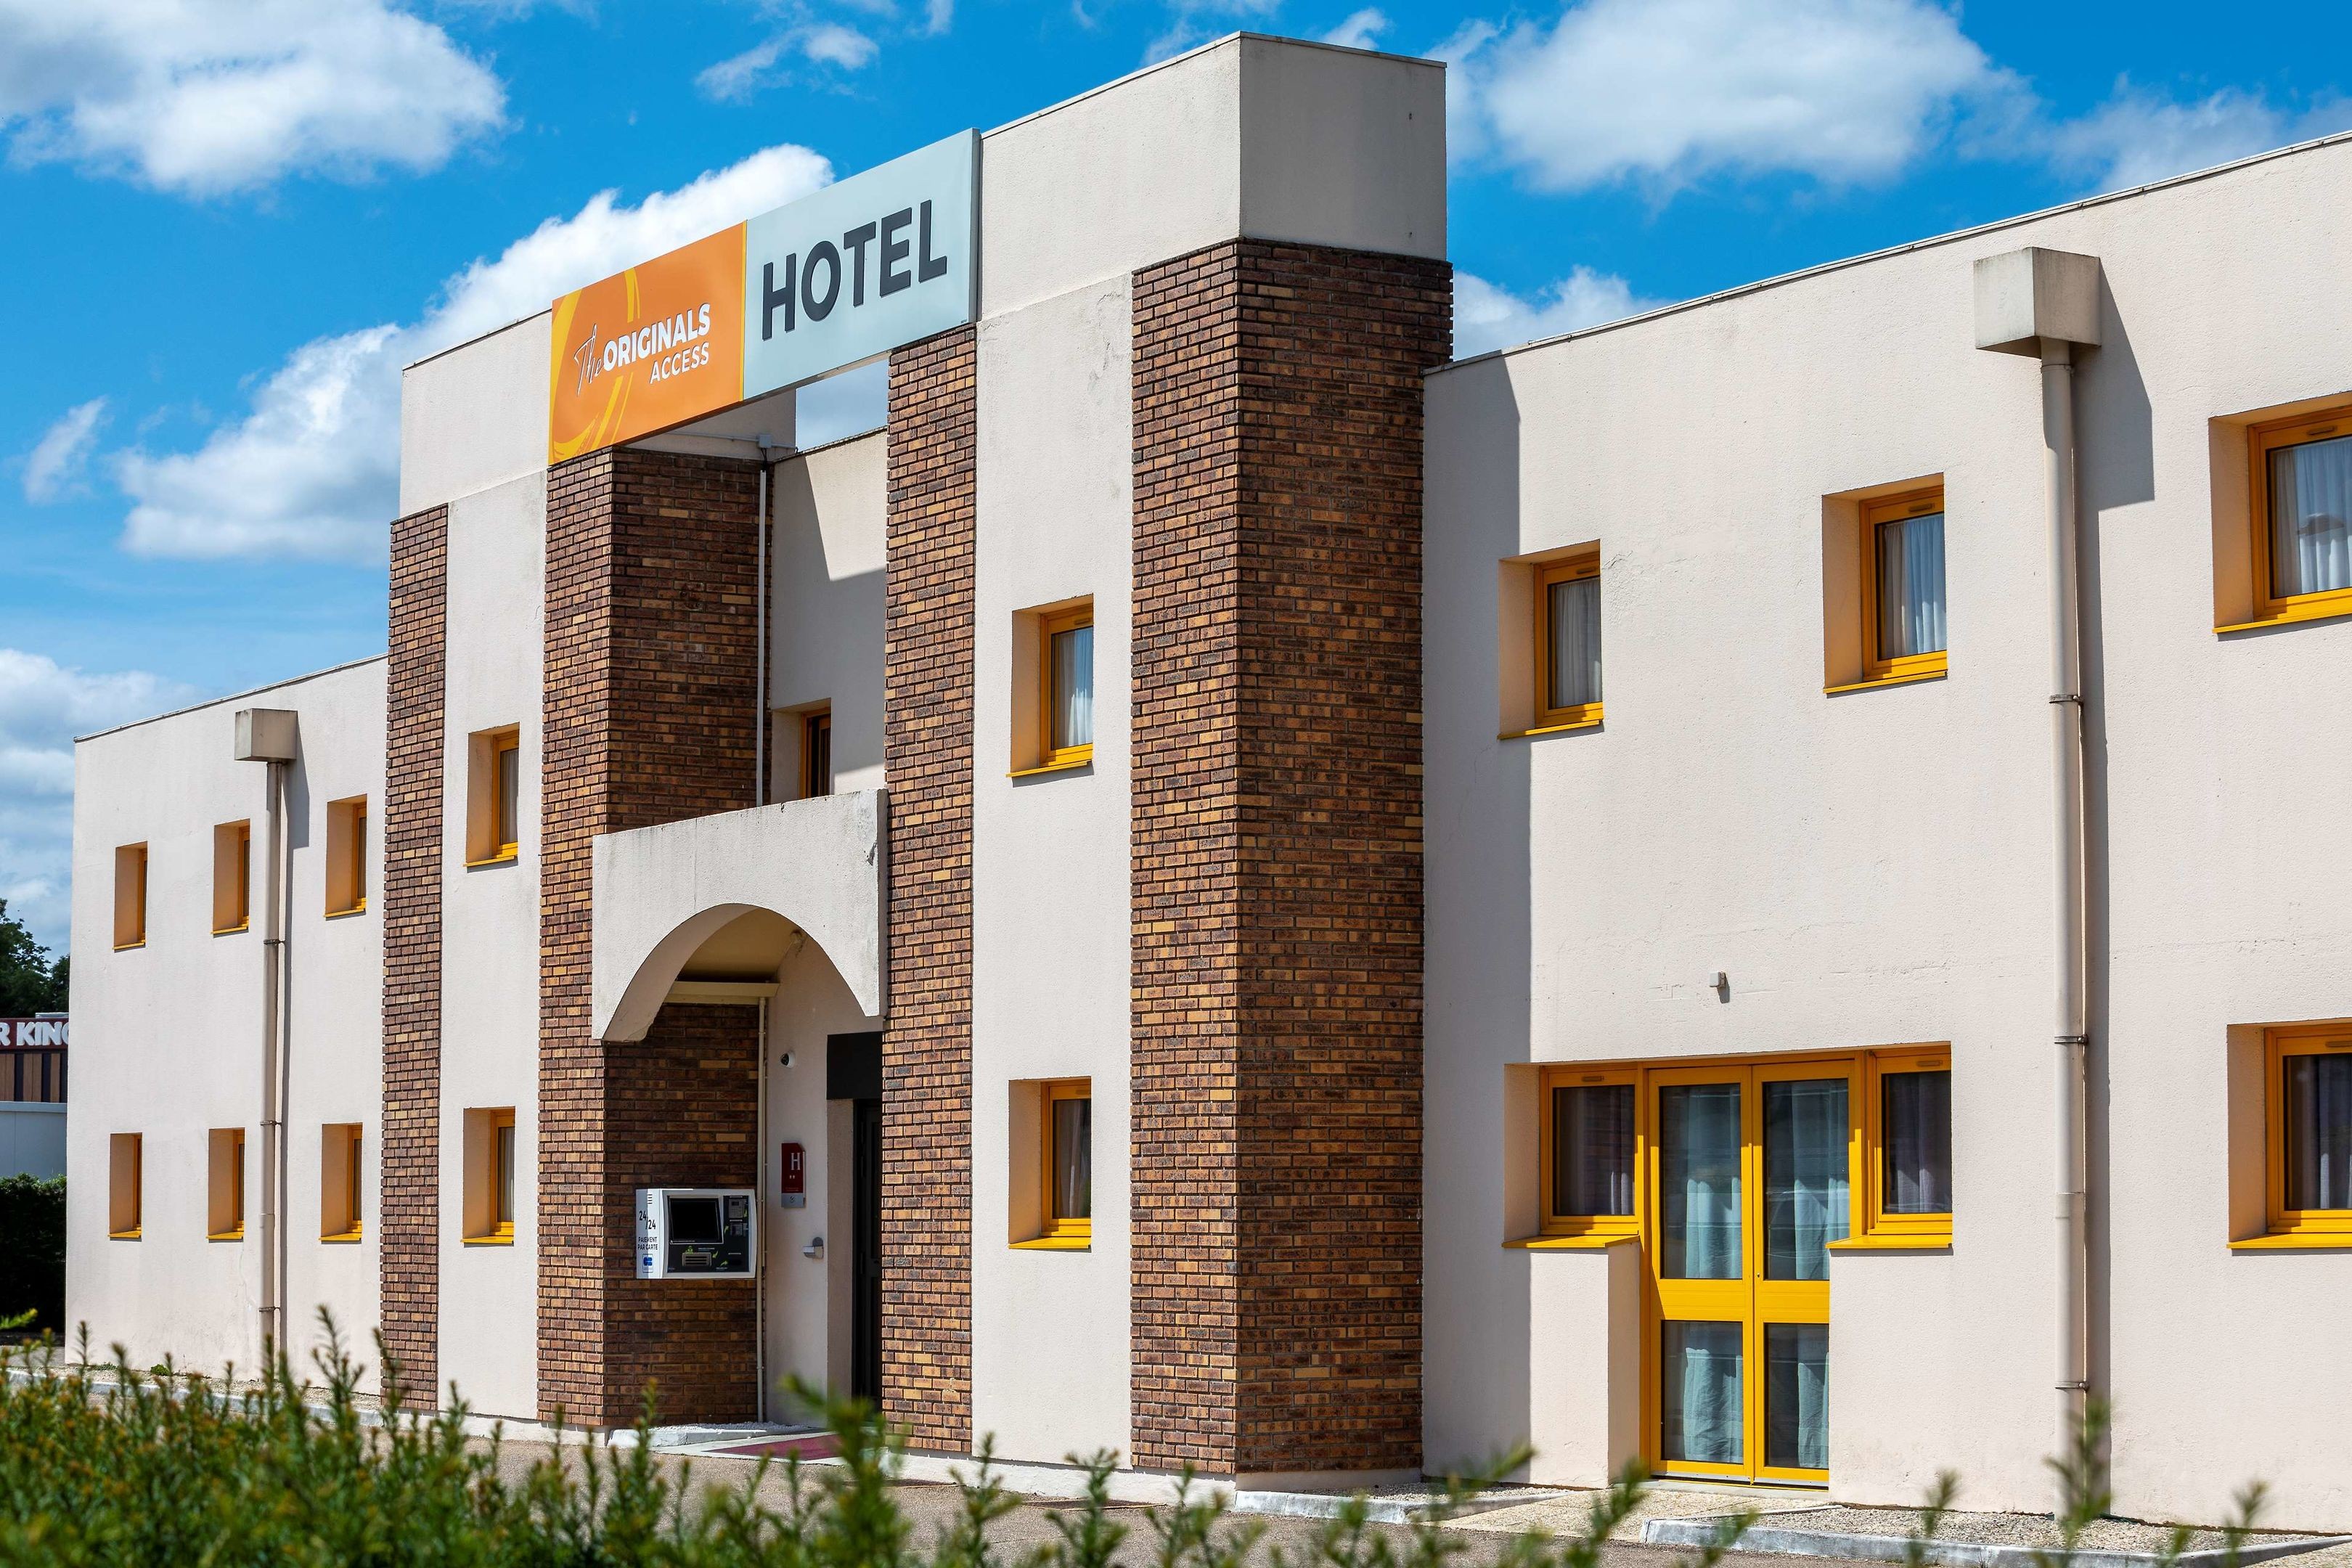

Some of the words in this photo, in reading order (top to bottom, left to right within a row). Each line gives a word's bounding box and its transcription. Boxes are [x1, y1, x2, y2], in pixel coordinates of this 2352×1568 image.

[762, 200, 947, 341] HOTEL
[574, 323, 604, 396] The
[603, 303, 711, 372] ORIGINALS
[650, 342, 709, 384] ACCESS
[791, 1153, 801, 1170] H
